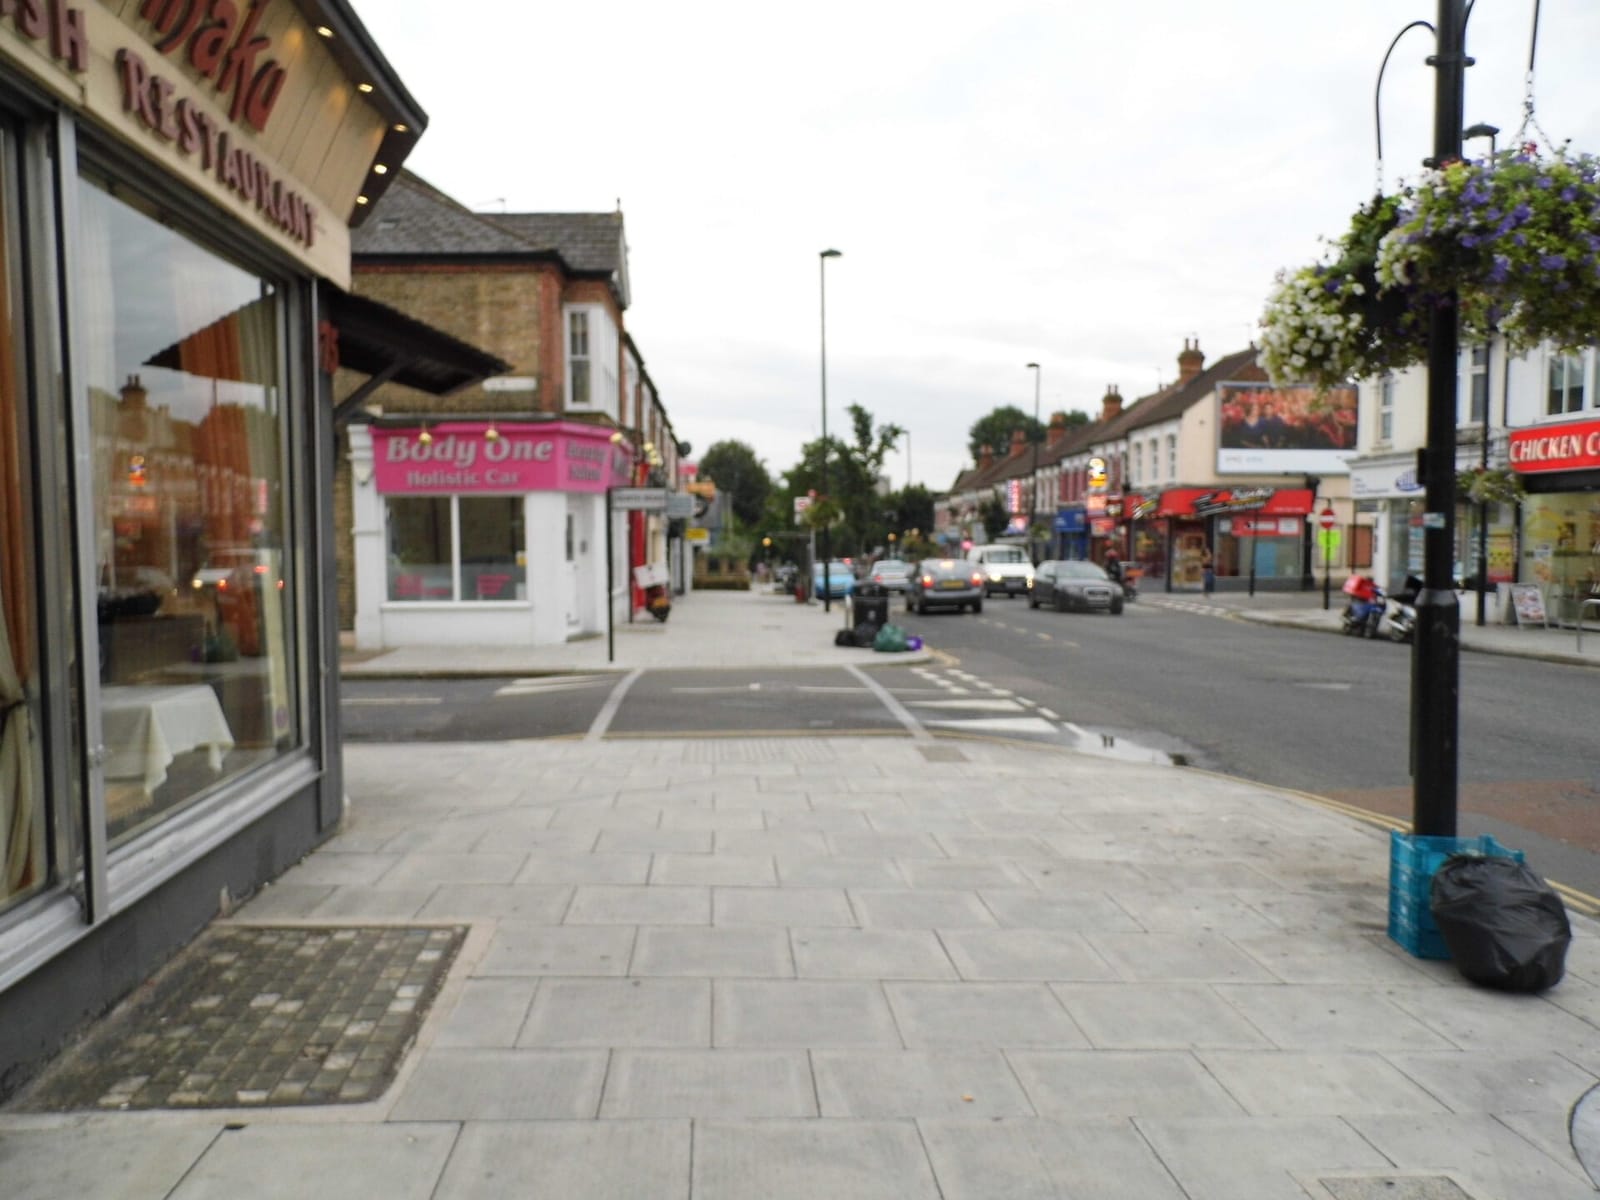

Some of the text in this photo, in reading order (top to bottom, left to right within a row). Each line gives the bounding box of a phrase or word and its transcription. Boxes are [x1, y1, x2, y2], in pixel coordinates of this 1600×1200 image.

[0, 0, 318, 248] SH RESTAURANT
[386, 434, 553, 469] Body One
[1509, 431, 1600, 463] CHICKEN C
[407, 469, 480, 487] Holistic
